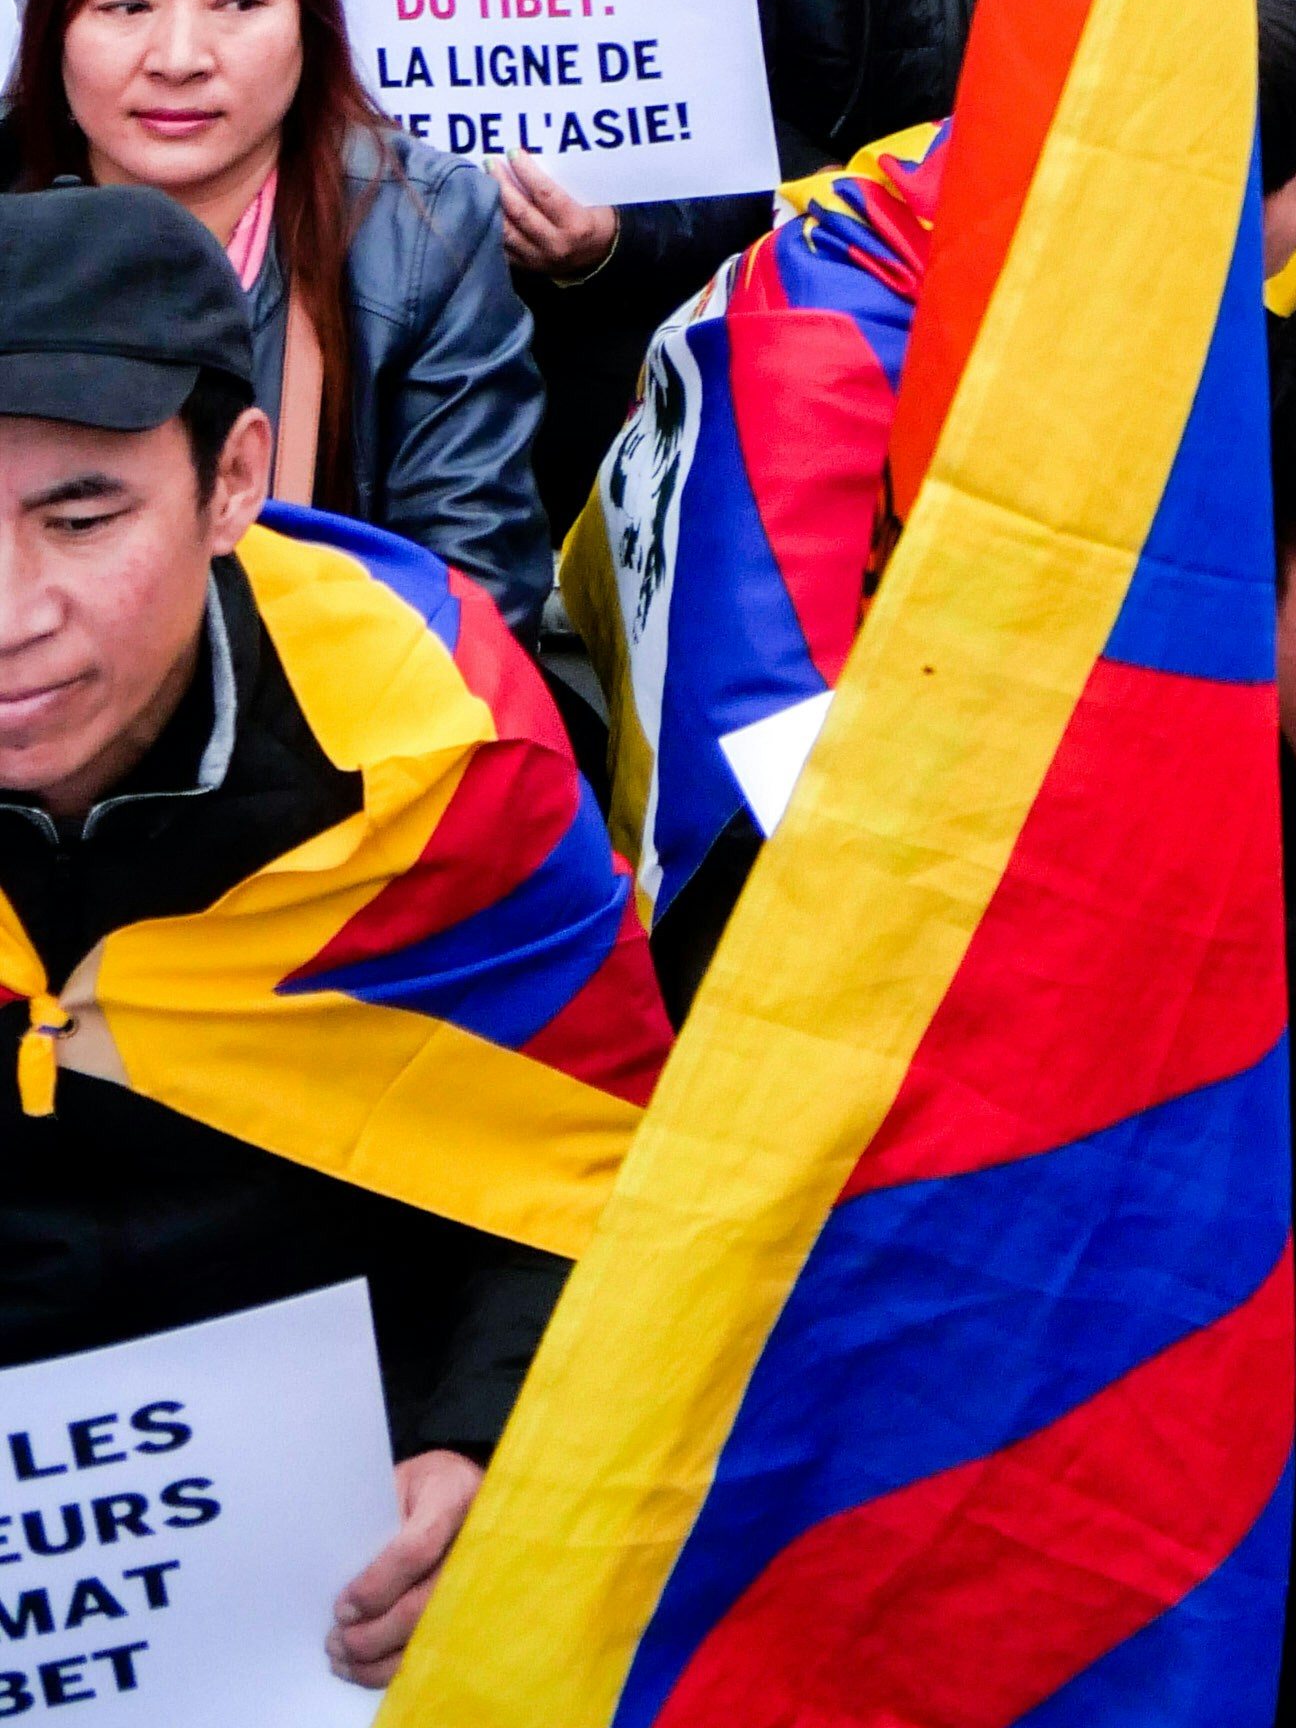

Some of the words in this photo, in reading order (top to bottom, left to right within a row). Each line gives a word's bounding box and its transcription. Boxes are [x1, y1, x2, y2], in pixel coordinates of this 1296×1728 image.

[377, 46, 432, 89] LA
[448, 42, 583, 88] LIGNE
[597, 39, 663, 84] DE
[448, 113, 505, 155] DE
[518, 101, 693, 156] L'ASIE!
[8, 1400, 193, 1482] LES
